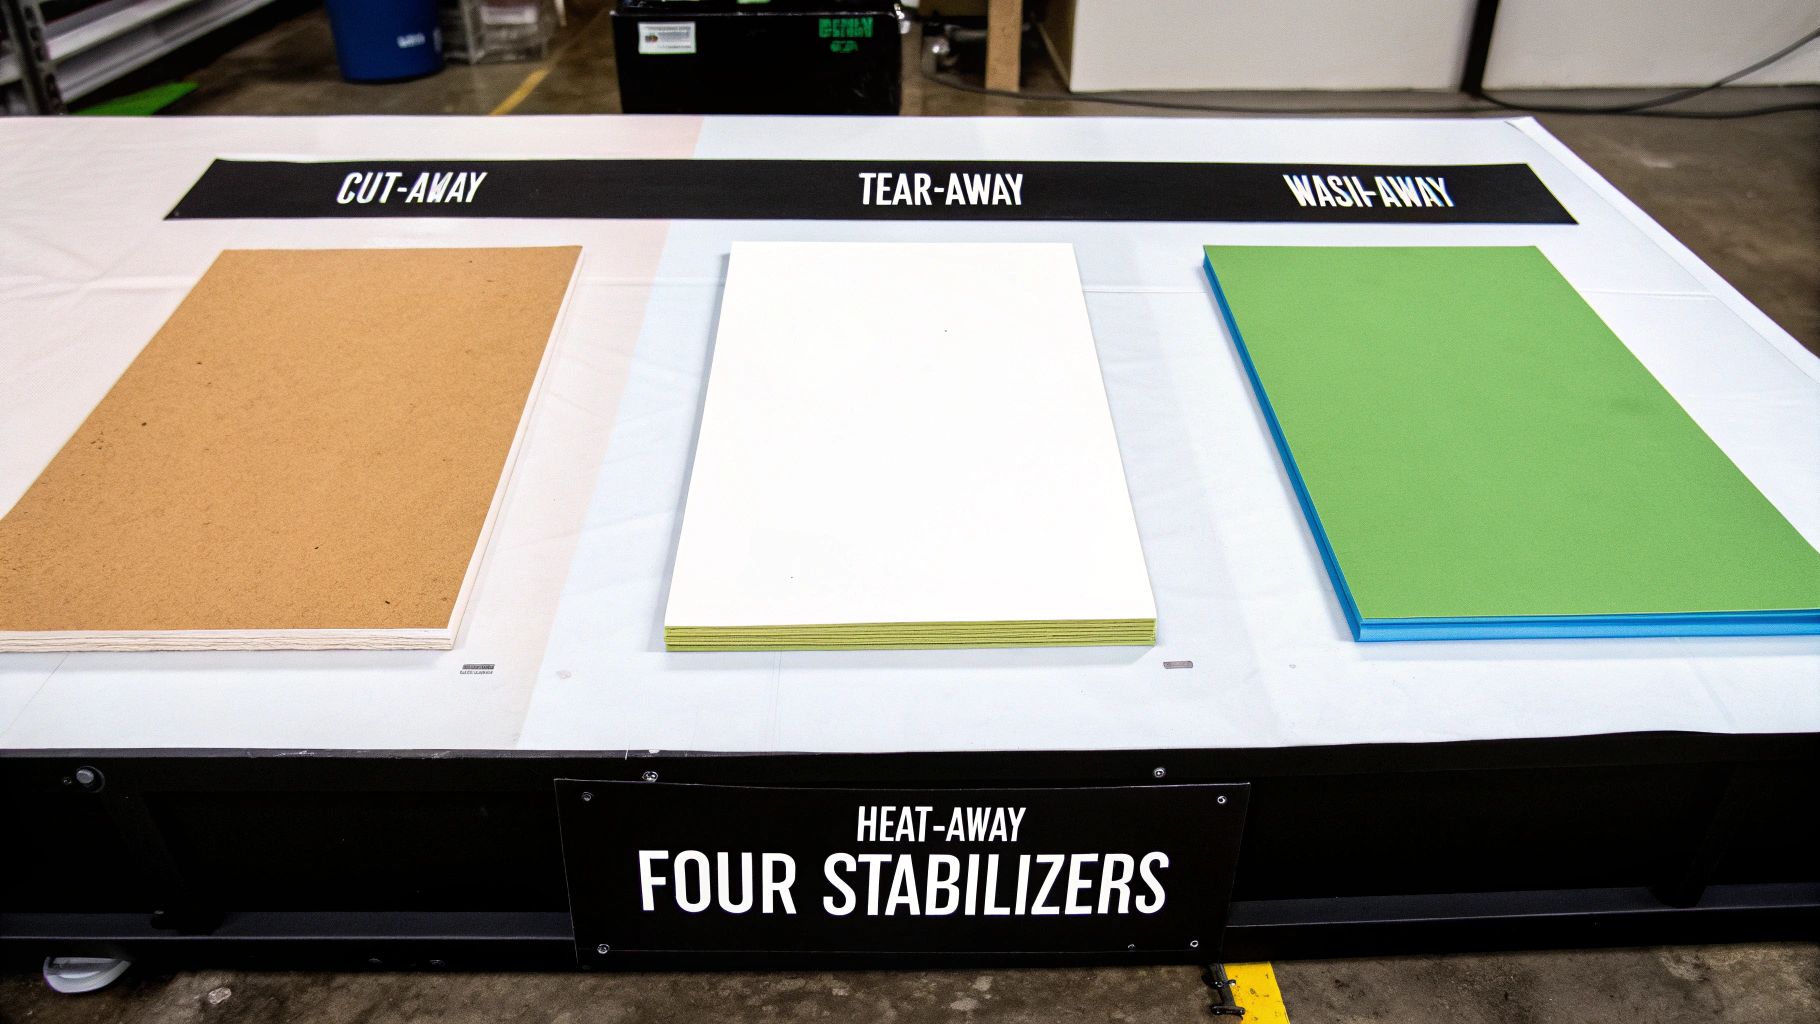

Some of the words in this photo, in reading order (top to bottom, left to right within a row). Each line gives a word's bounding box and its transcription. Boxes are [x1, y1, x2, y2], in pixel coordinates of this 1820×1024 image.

[336, 171, 488, 204] CUT-AWAY
[858, 172, 1024, 206] TEAR-AWAY
[856, 805, 1027, 843] HEAT-AWAY
[638, 849, 797, 915] FOUR
[822, 851, 1170, 916] STABILIZERS
